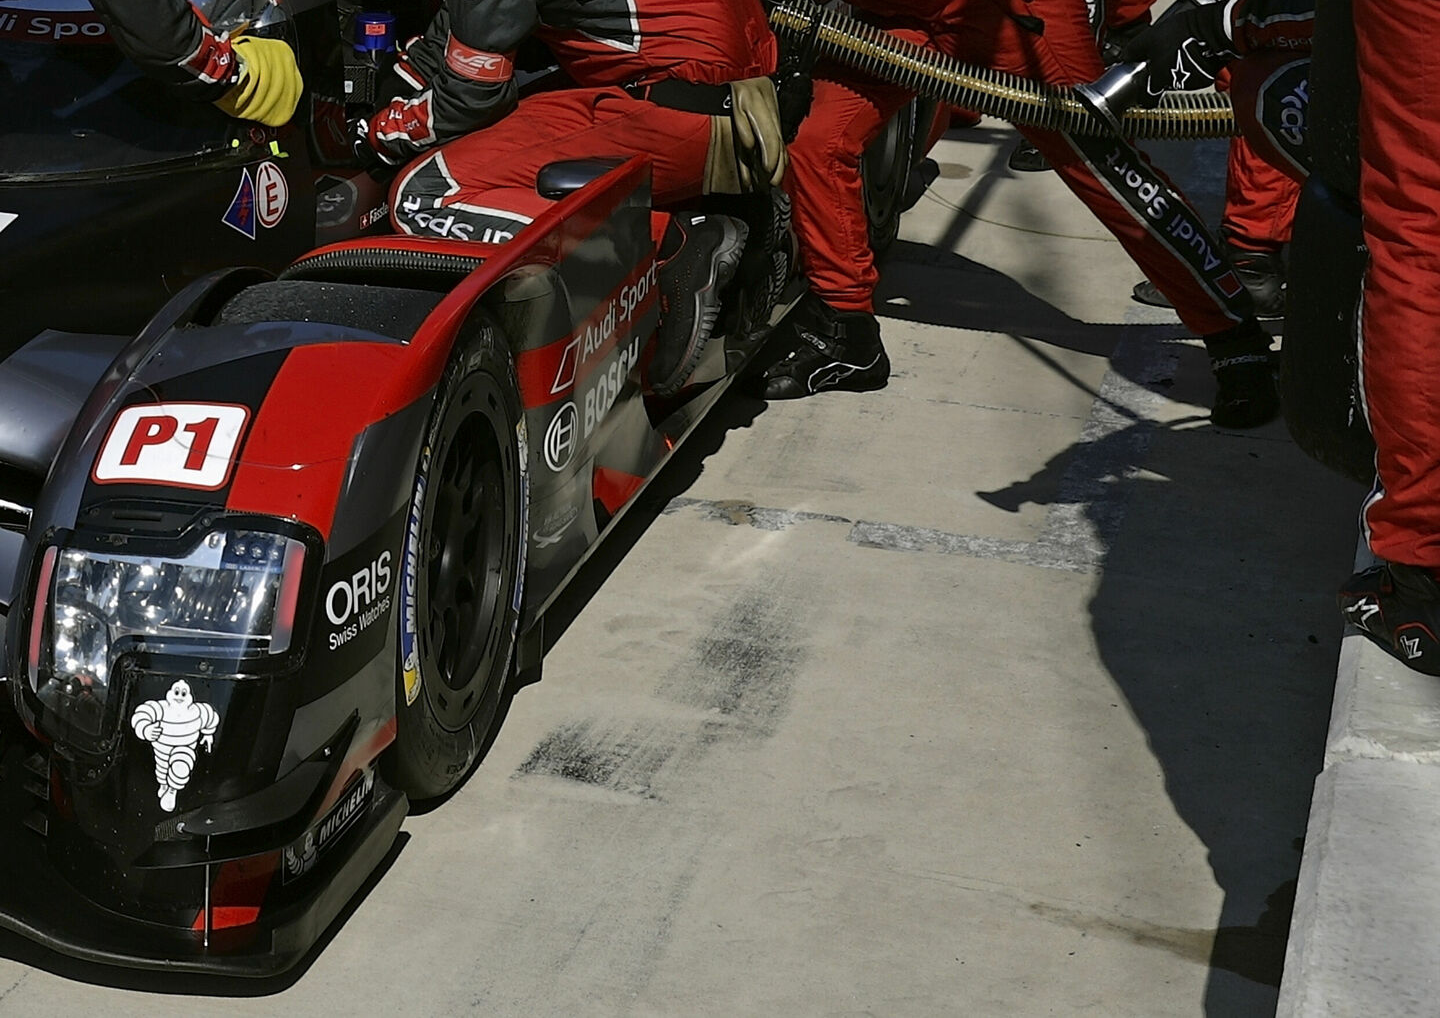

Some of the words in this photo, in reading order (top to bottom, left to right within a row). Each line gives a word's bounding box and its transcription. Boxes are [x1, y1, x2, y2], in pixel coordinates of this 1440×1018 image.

[27, 17, 107, 40] Spo
[1106, 147, 1170, 220] Sport
[1167, 214, 1221, 272] Audi
[582, 301, 617, 364] Audi
[620, 260, 658, 323] Sport
[119, 413, 225, 472] P1
[325, 550, 392, 626] ORIS
[405, 480, 426, 634] MICHELIN
[328, 623, 358, 651] Swiss
[358, 594, 391, 633] Watches
[318, 767, 375, 846] MICHELIN
